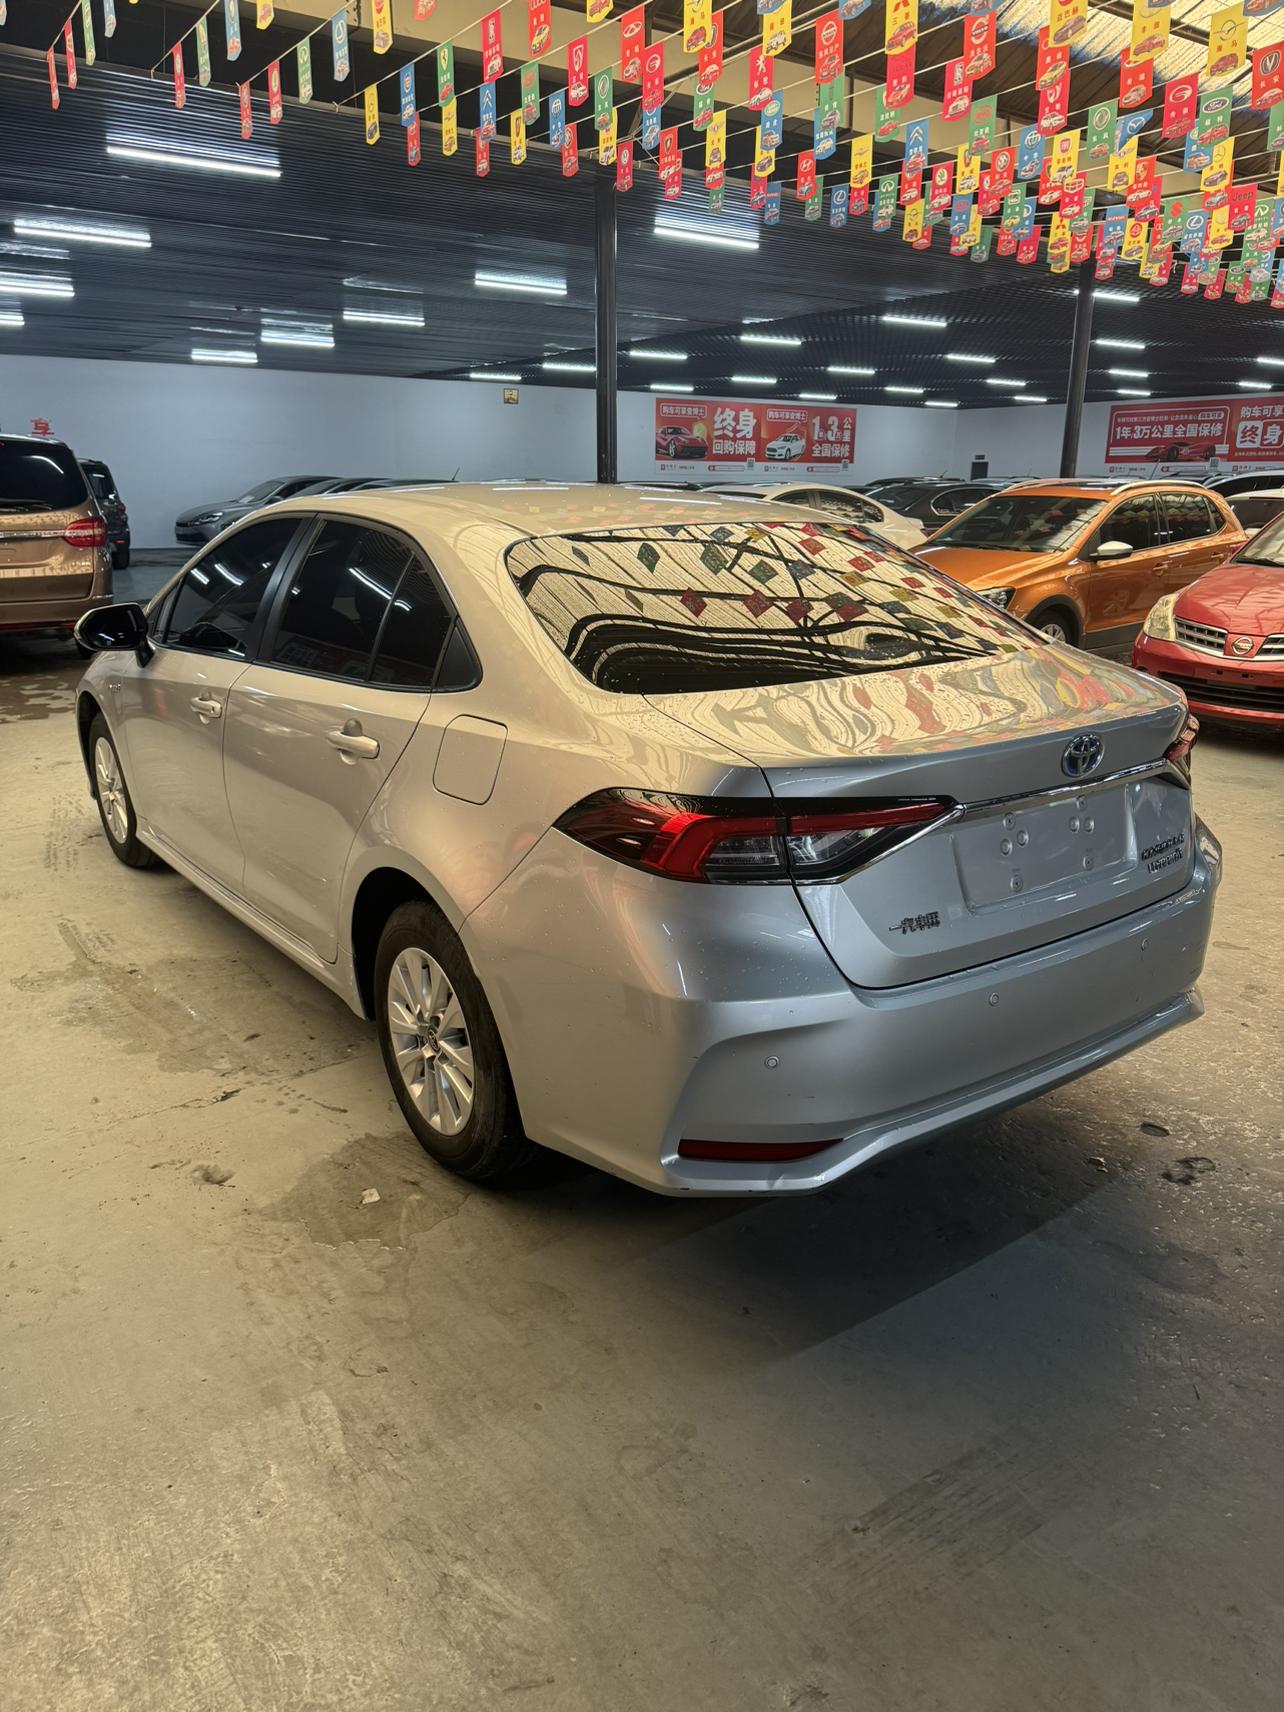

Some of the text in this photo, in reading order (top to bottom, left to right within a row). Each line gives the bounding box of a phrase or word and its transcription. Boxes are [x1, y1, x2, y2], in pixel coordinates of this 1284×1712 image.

[713, 407, 757, 438] 终身
[1239, 424, 1282, 445] 终身
[712, 439, 756, 455] 回购保障
[811, 443, 850, 458] 全国保修
